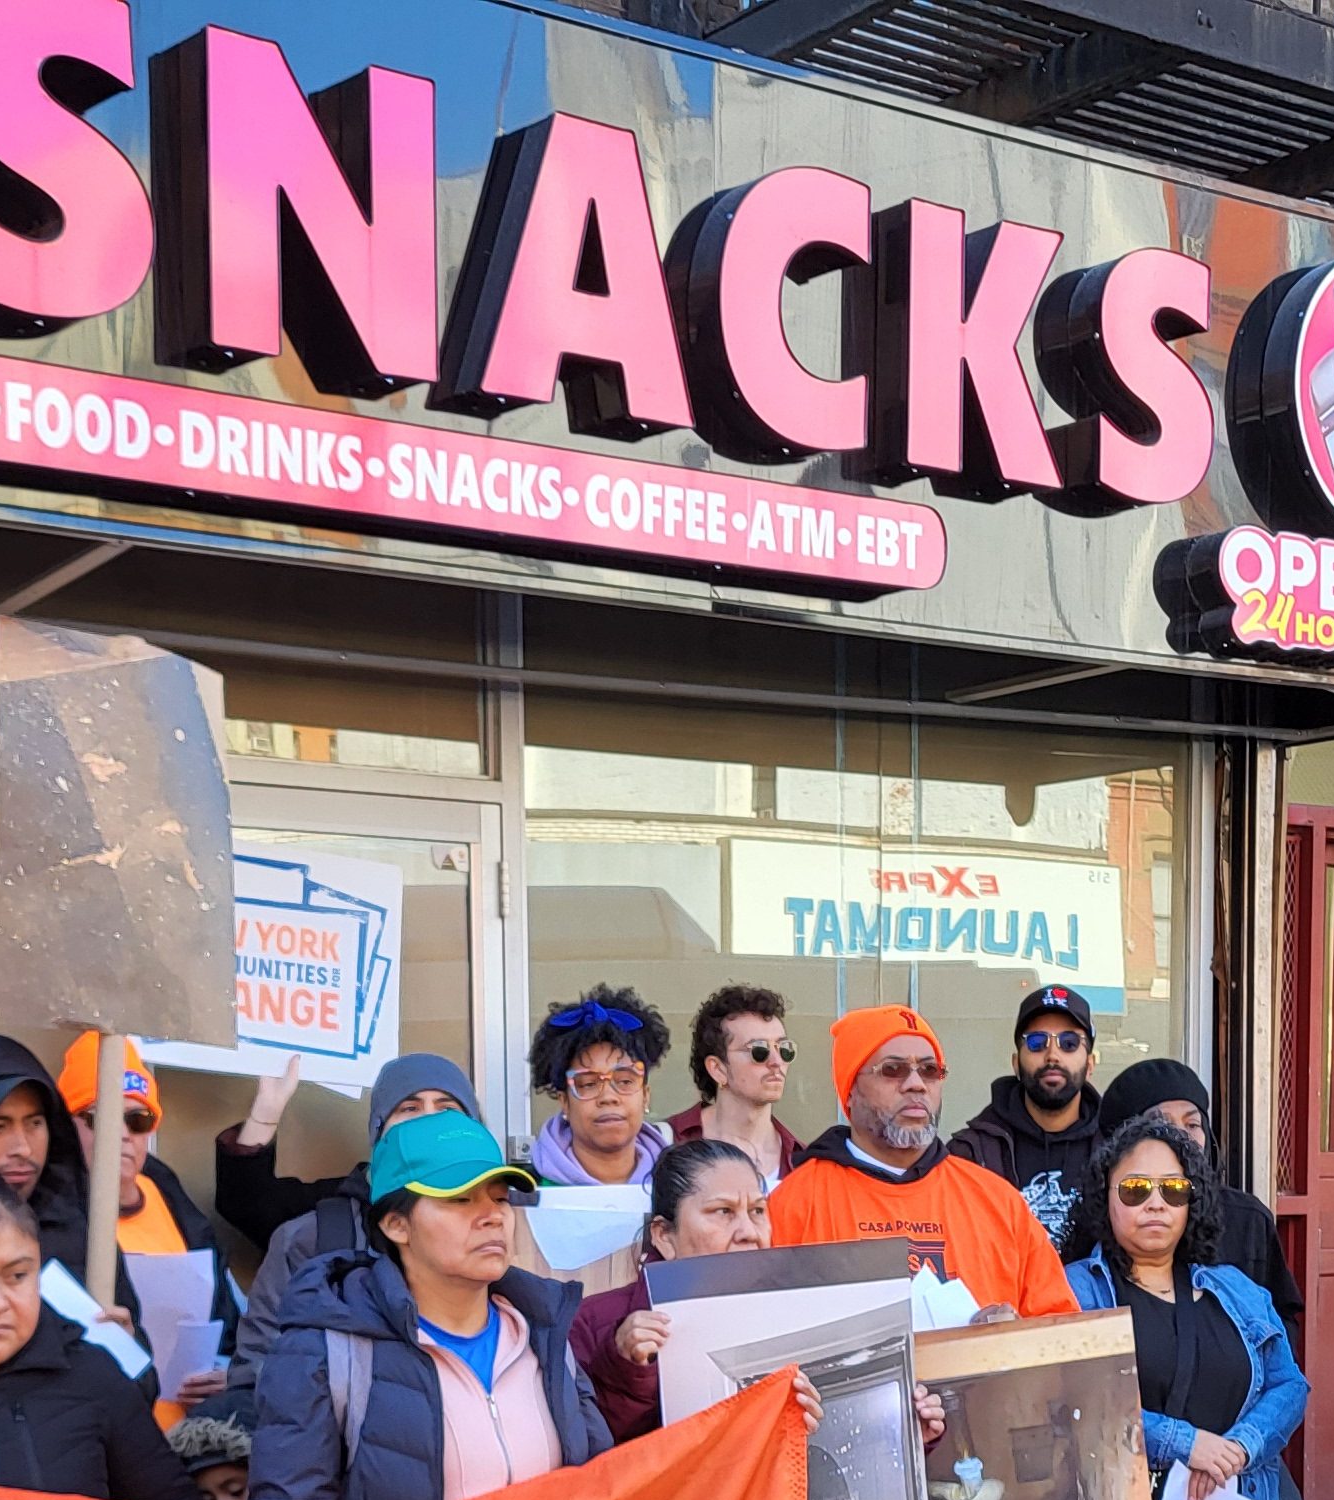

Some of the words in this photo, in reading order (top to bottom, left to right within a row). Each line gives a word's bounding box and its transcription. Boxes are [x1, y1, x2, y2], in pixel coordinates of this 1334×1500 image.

[5, 383, 152, 460] FOOD
[179, 413, 363, 493] DRINKS
[388, 443, 563, 520] SNACKS
[583, 475, 727, 546] COFFEE
[747, 499, 836, 561] ATM
[856, 516, 924, 570] EBT
[1239, 590, 1295, 641] 24
[255, 920, 341, 962] YORK
[332, 968, 341, 988] FOR
[858, 1221, 893, 1233] CASA
